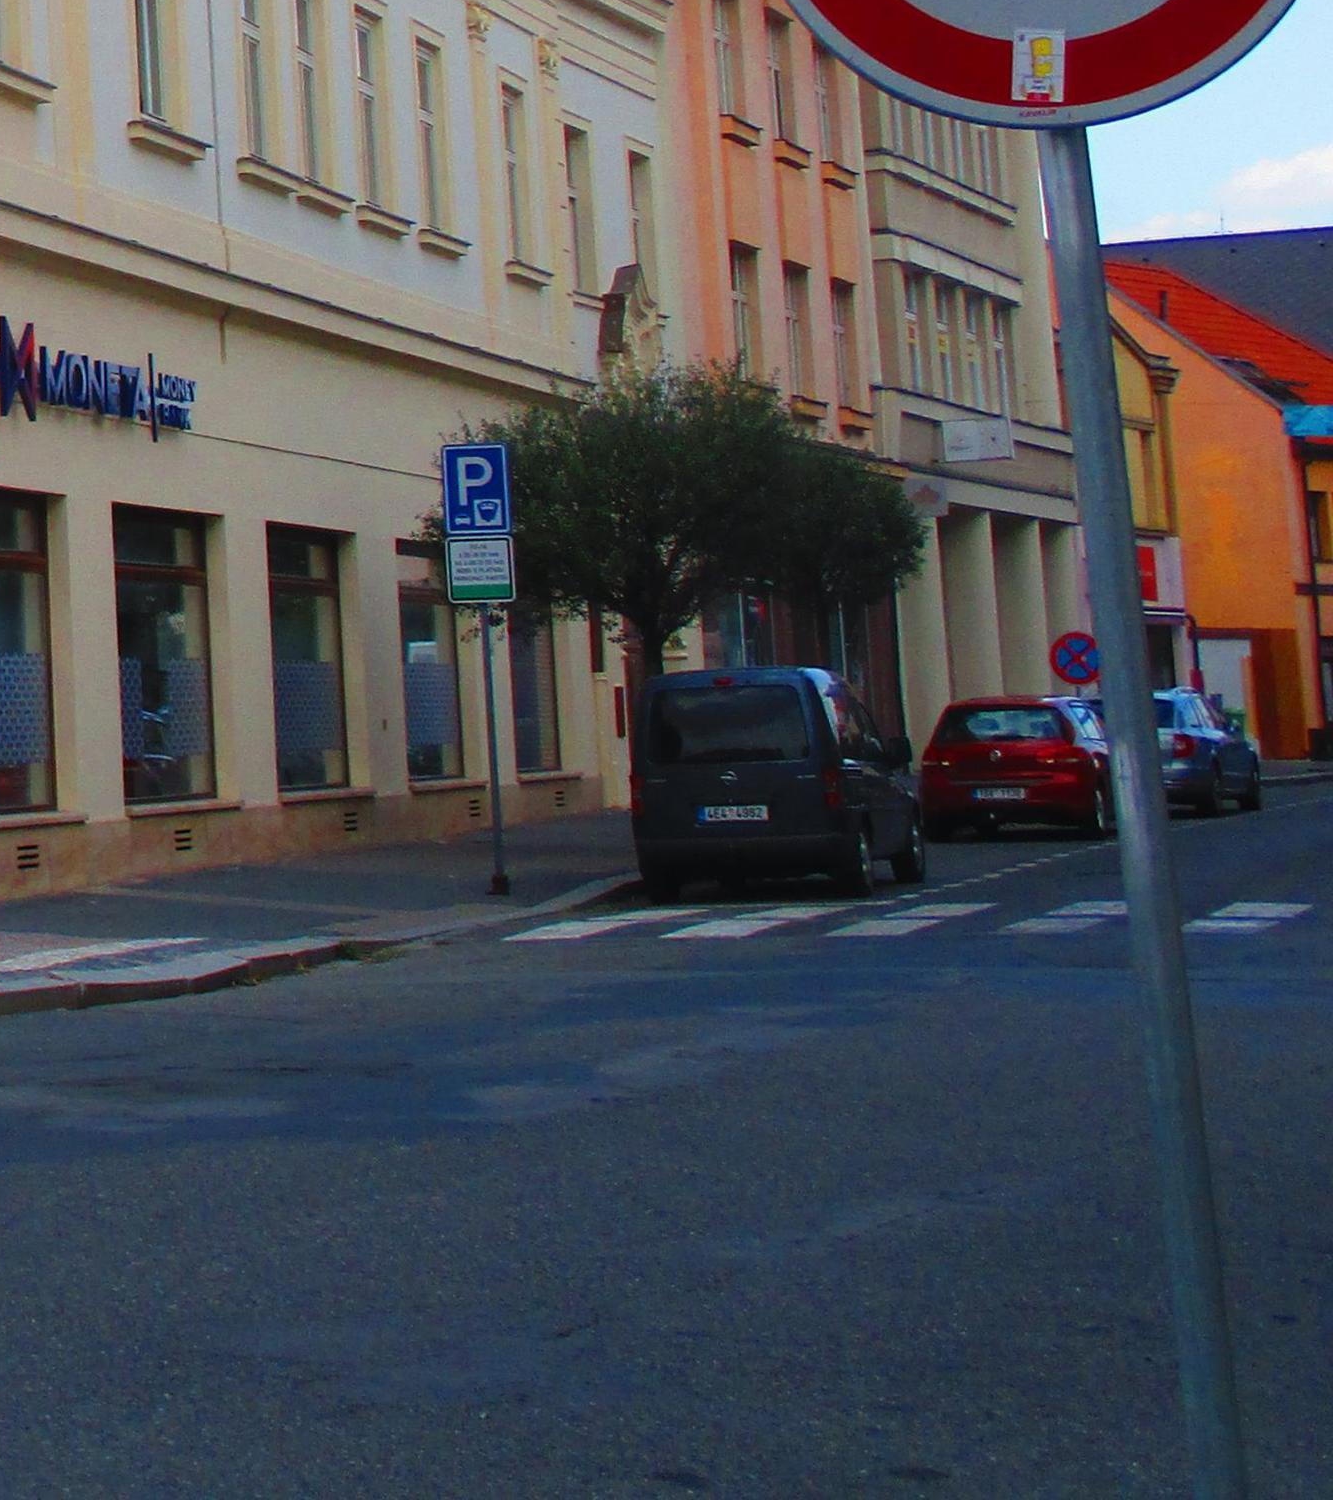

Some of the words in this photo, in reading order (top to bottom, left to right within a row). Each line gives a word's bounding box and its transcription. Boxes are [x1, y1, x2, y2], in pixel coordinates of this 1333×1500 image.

[38, 346, 150, 420] MONETA
[157, 372, 198, 402] MONEY
[457, 457, 493, 506] P
